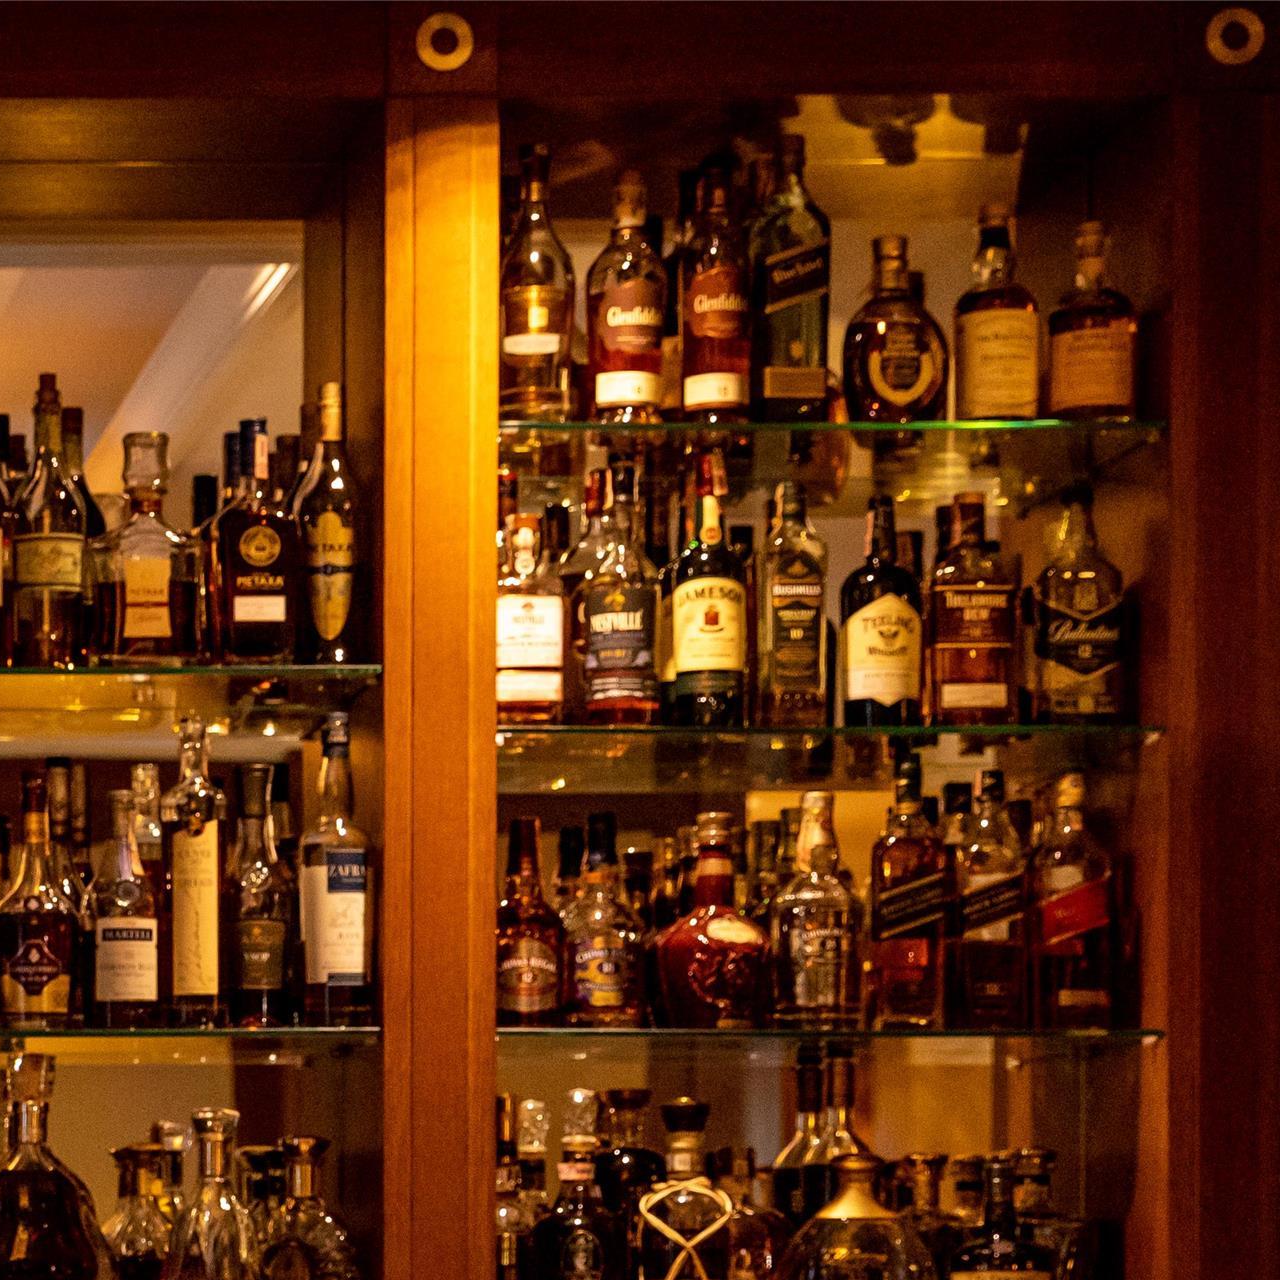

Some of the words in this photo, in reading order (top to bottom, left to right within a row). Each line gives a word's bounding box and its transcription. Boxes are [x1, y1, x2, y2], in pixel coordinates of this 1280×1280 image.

[235, 575, 284, 591] METAXA
[677, 585, 744, 608] JAMESON
[329, 864, 366, 878] ZAFR
[105, 931, 152, 941] MARTELL
